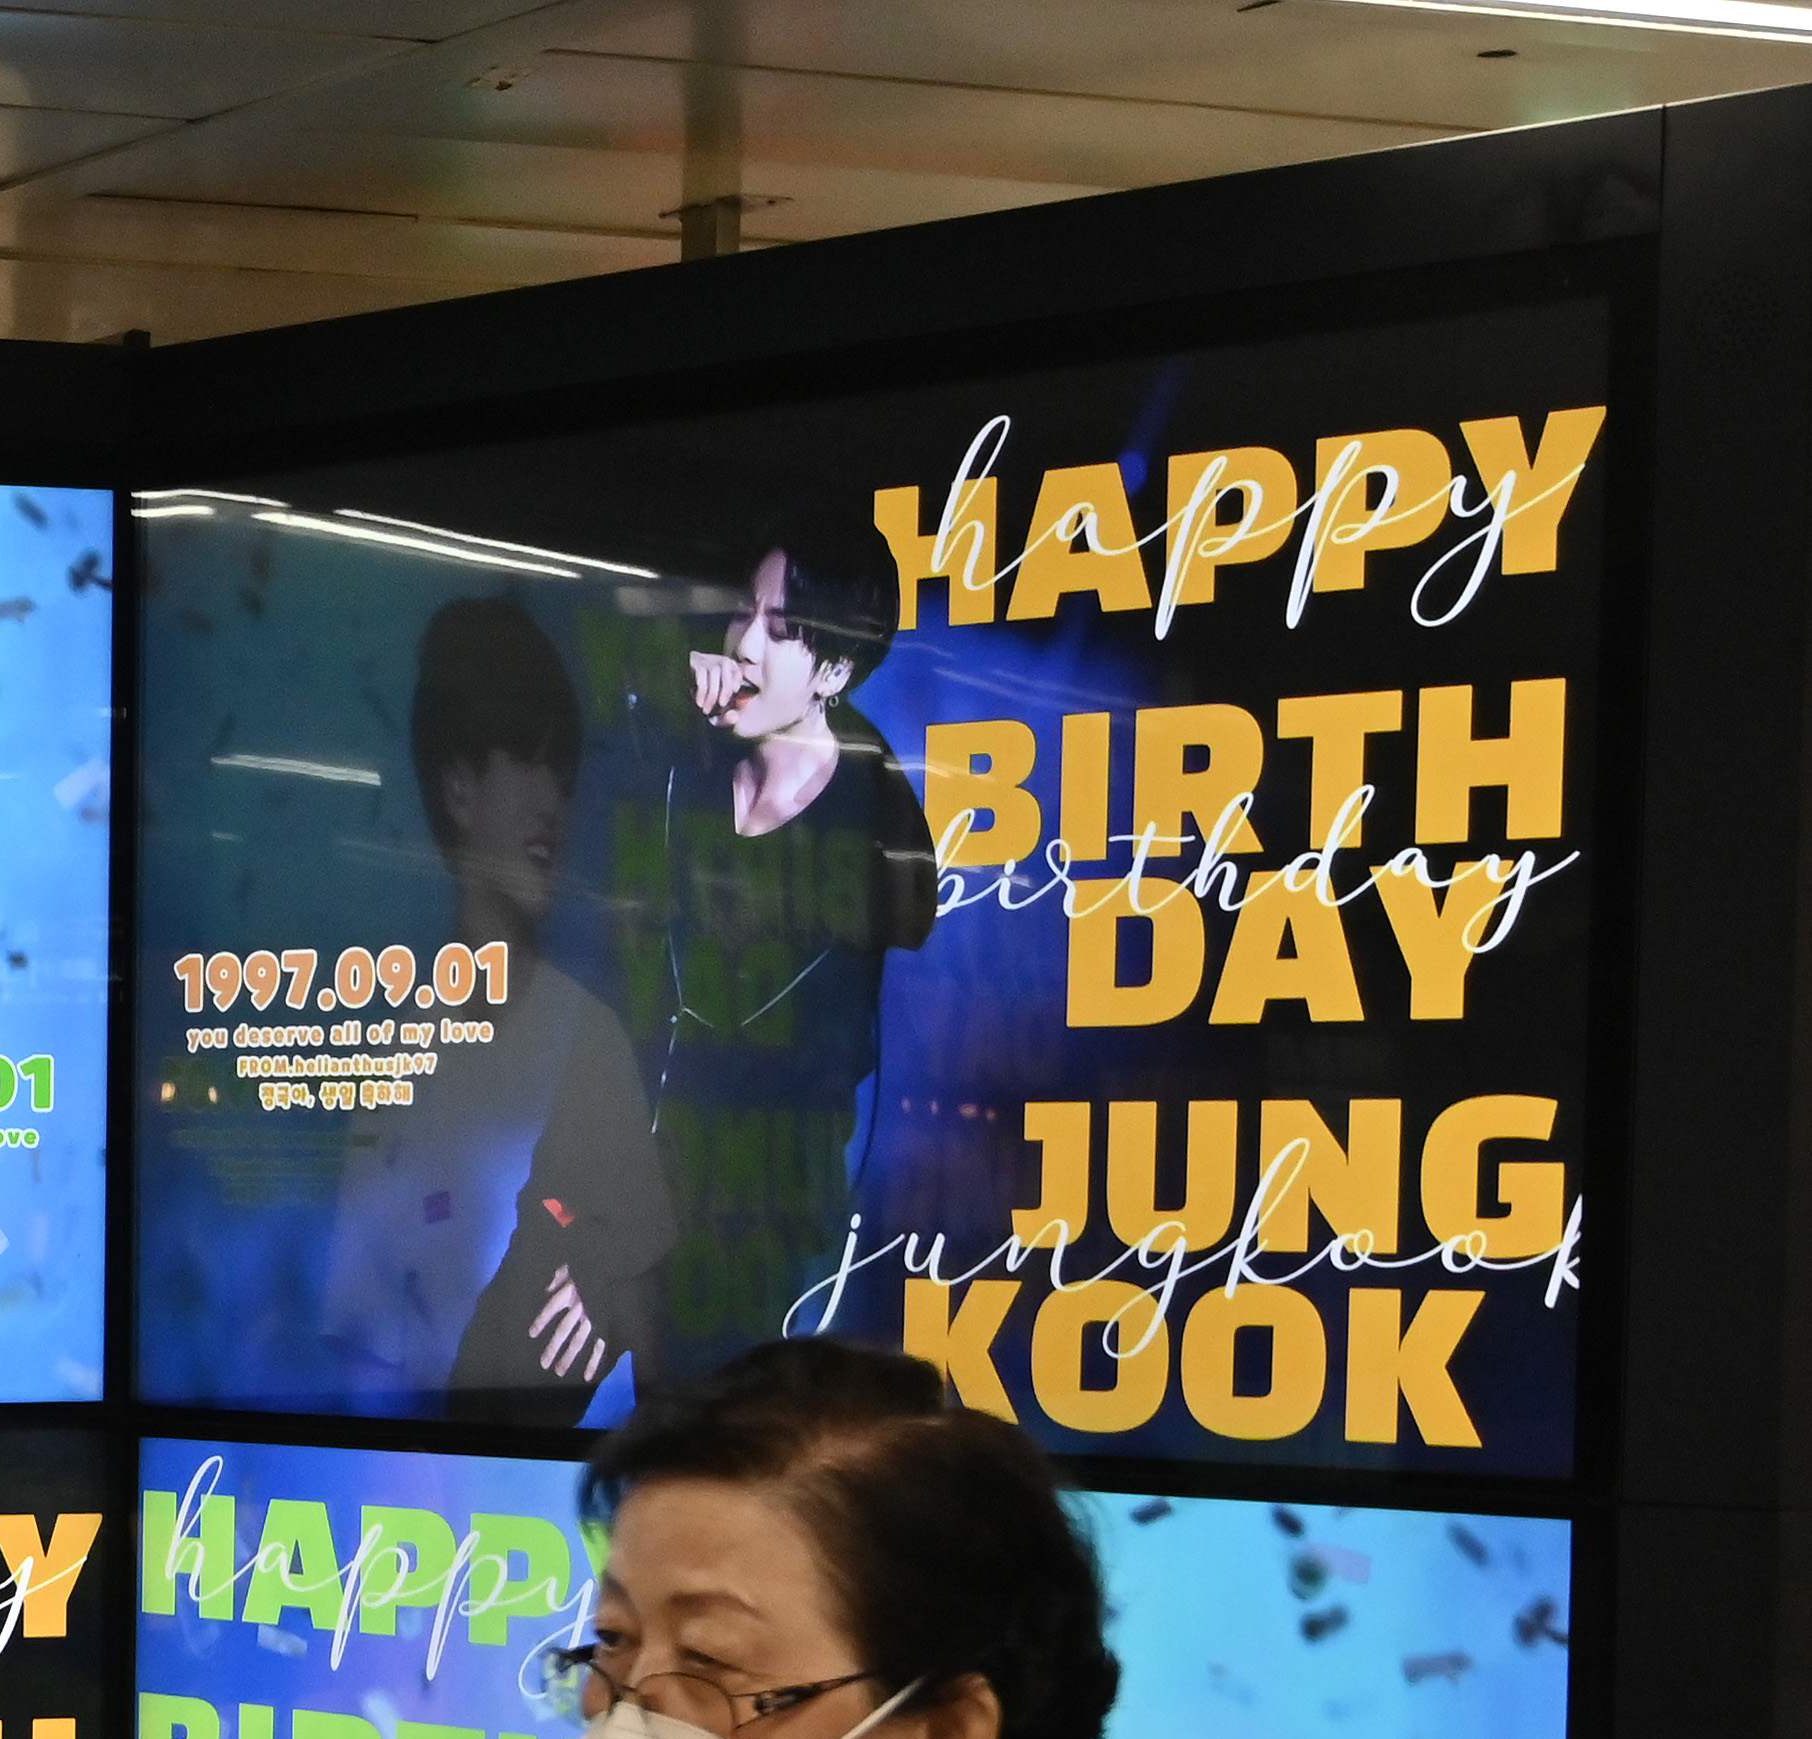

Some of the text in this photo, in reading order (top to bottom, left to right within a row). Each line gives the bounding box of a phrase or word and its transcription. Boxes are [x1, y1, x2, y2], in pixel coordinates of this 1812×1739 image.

[873, 406, 1607, 631] HAPPY
[929, 414, 1586, 640] happy
[923, 678, 1566, 869] BIRTH
[936, 784, 1581, 954] birthday
[1065, 860, 1517, 1029] DAY
[174, 941, 509, 1013] 1997.09.01
[187, 1018, 494, 1053] you deserve all of my love
[320, 1081, 356, 1109] 생일
[1012, 1095, 1565, 1258] JUNG
[782, 1138, 1582, 1358] jungkook
[901, 1277, 1486, 1449] KOOK
[142, 1490, 613, 1647] HAPP
[165, 1455, 598, 1700] happy
